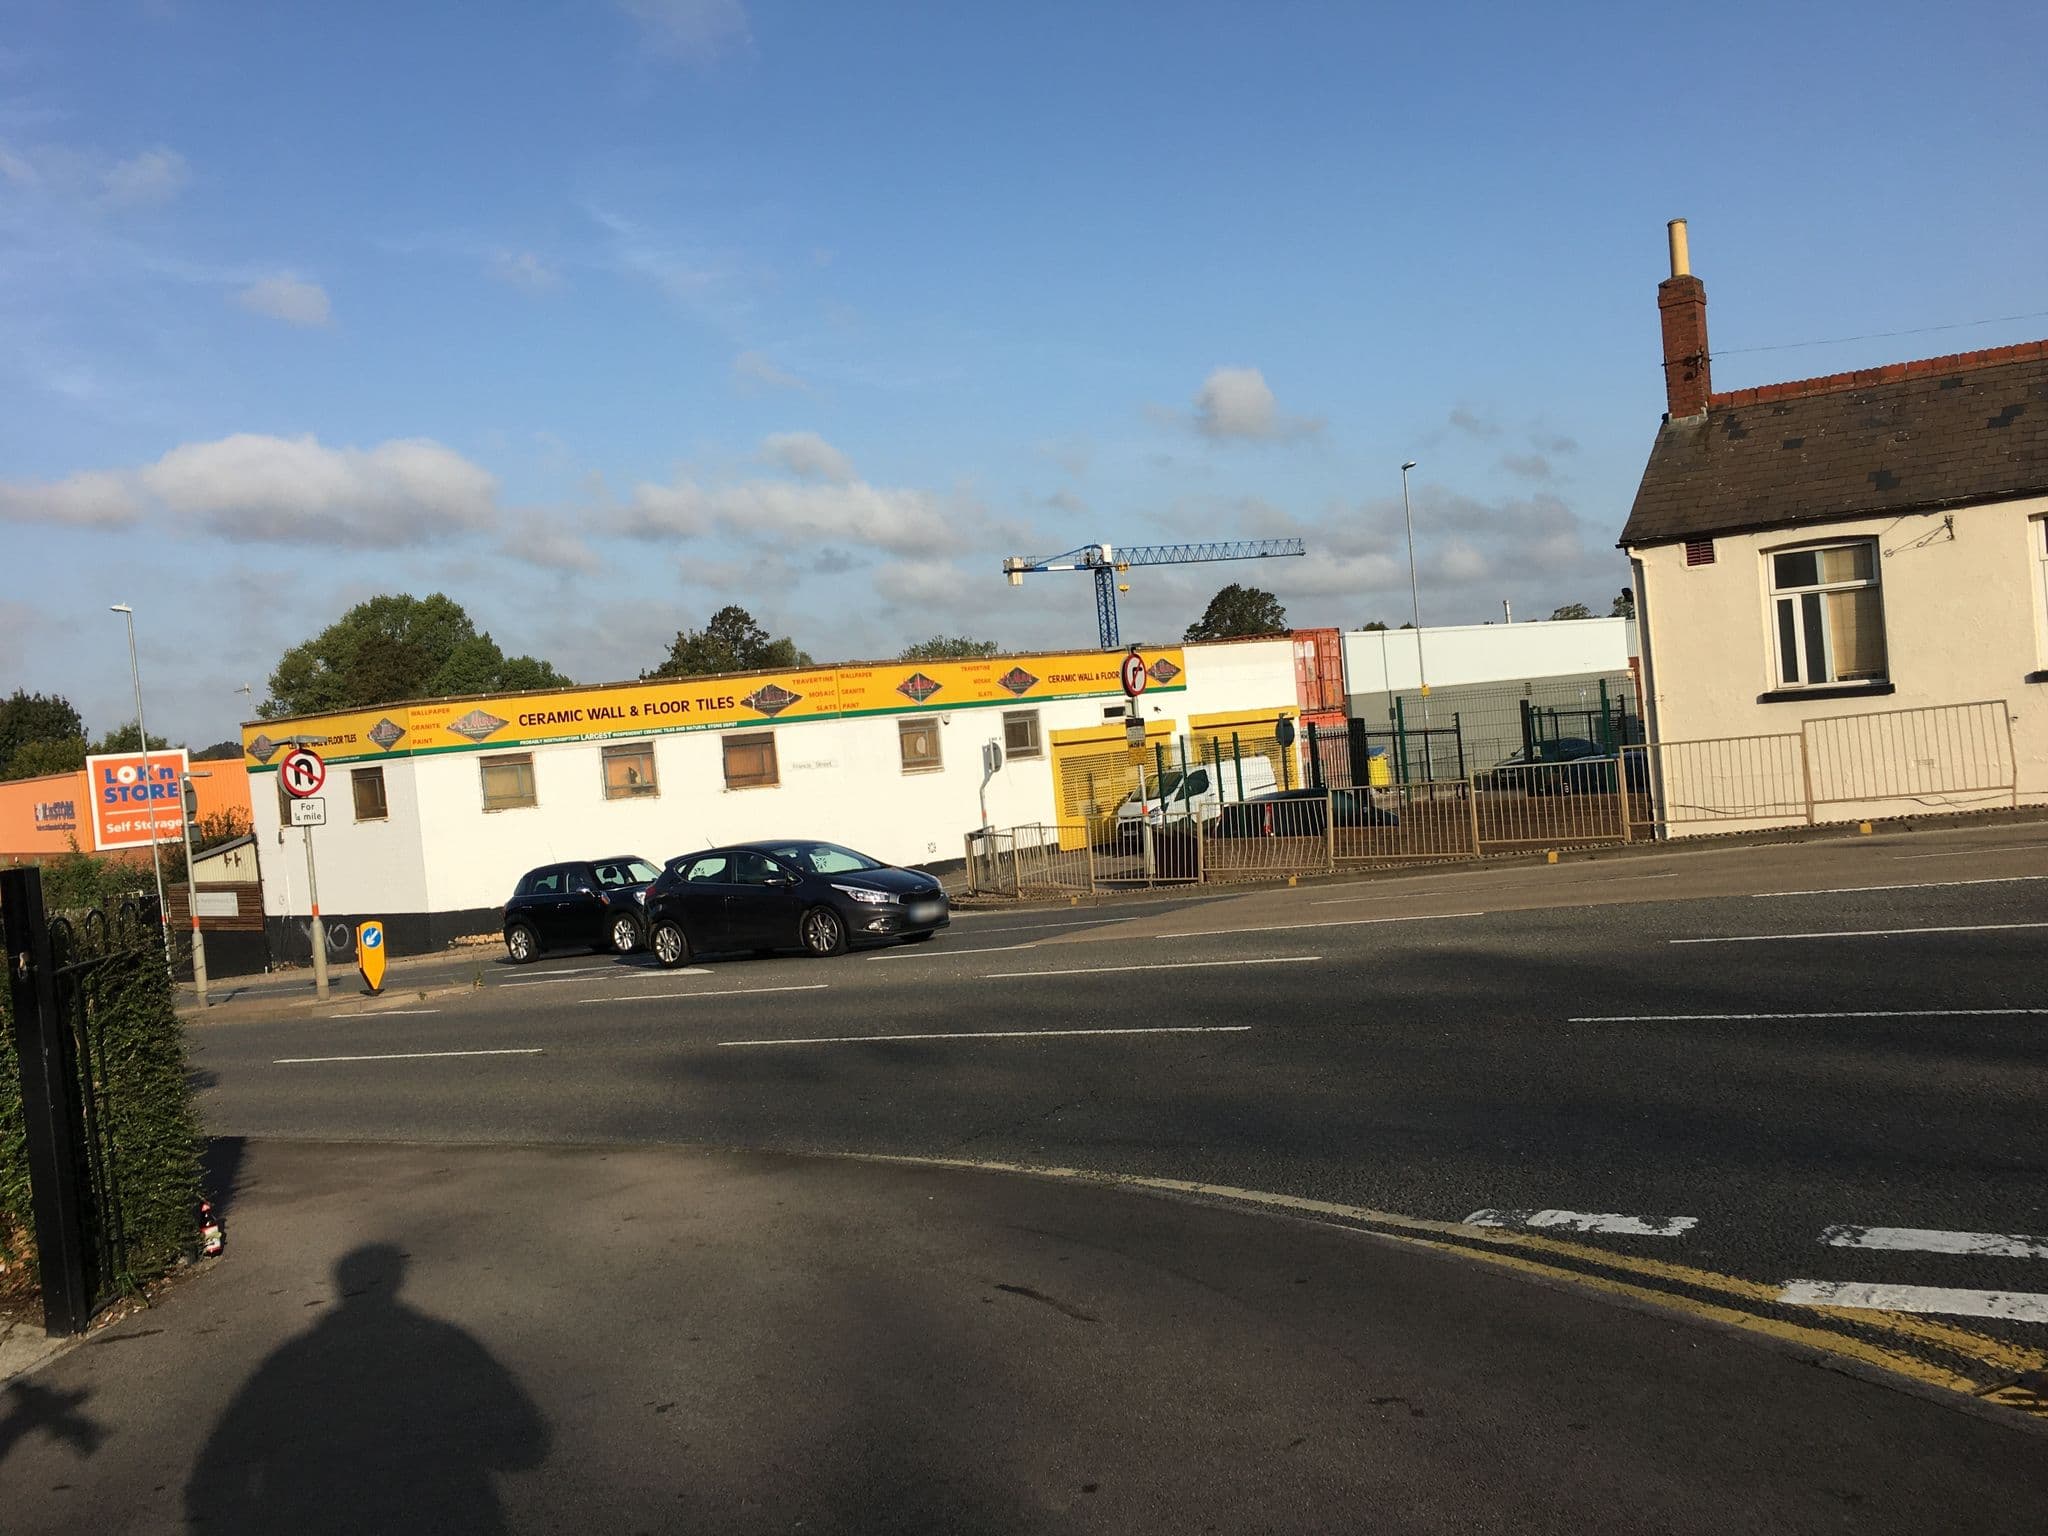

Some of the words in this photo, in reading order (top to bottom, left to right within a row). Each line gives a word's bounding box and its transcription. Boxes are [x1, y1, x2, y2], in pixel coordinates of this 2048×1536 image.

[840, 671, 873, 679] WALLPAPER
[1048, 673, 1076, 684] CERAMIC
[1078, 672, 1095, 681] WALL
[1101, 671, 1120, 680] FLOOR
[792, 676, 834, 685] TRAVERTINE
[809, 690, 835, 698] MOSAIC
[841, 687, 865, 695] GRANITE
[411, 707, 450, 716] WALLPAPER
[519, 709, 583, 726] CERAMIC
[587, 706, 625, 720] WALL
[630, 705, 639, 717] &
[644, 700, 690, 715] FLOOR
[696, 696, 735, 711] TILES
[411, 723, 441, 731] GRANITE
[328, 736, 343, 745] FLOOR
[344, 733, 357, 744] TILES
[580, 732, 612, 740] LARGEST
[105, 764, 174, 784] LOK'n
[104, 782, 179, 804] STORE
[300, 803, 315, 811] For
[303, 812, 322, 821] mile
[106, 821, 131, 834] Self
[134, 819, 183, 831] Storage
